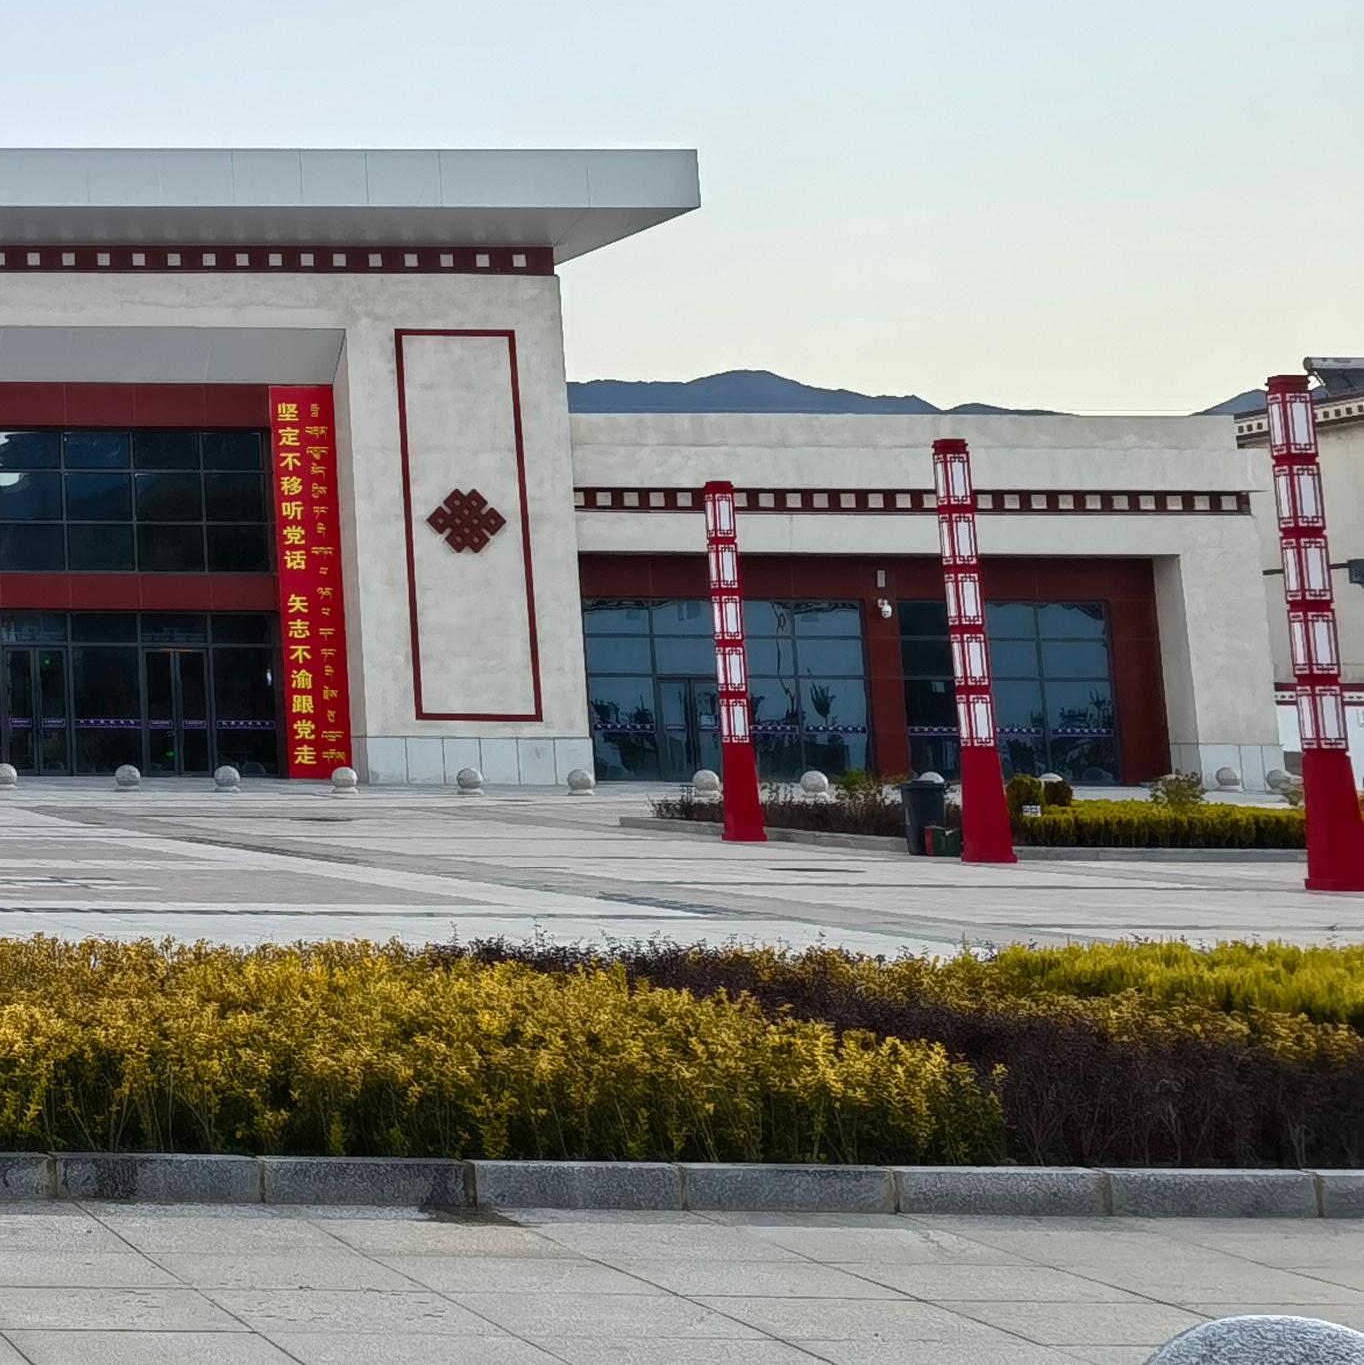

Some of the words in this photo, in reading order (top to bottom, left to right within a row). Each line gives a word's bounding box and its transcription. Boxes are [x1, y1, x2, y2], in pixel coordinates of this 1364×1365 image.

[277, 402, 306, 570] 坚定不移听党话
[287, 593, 317, 765] 矢志不渝跟党走
